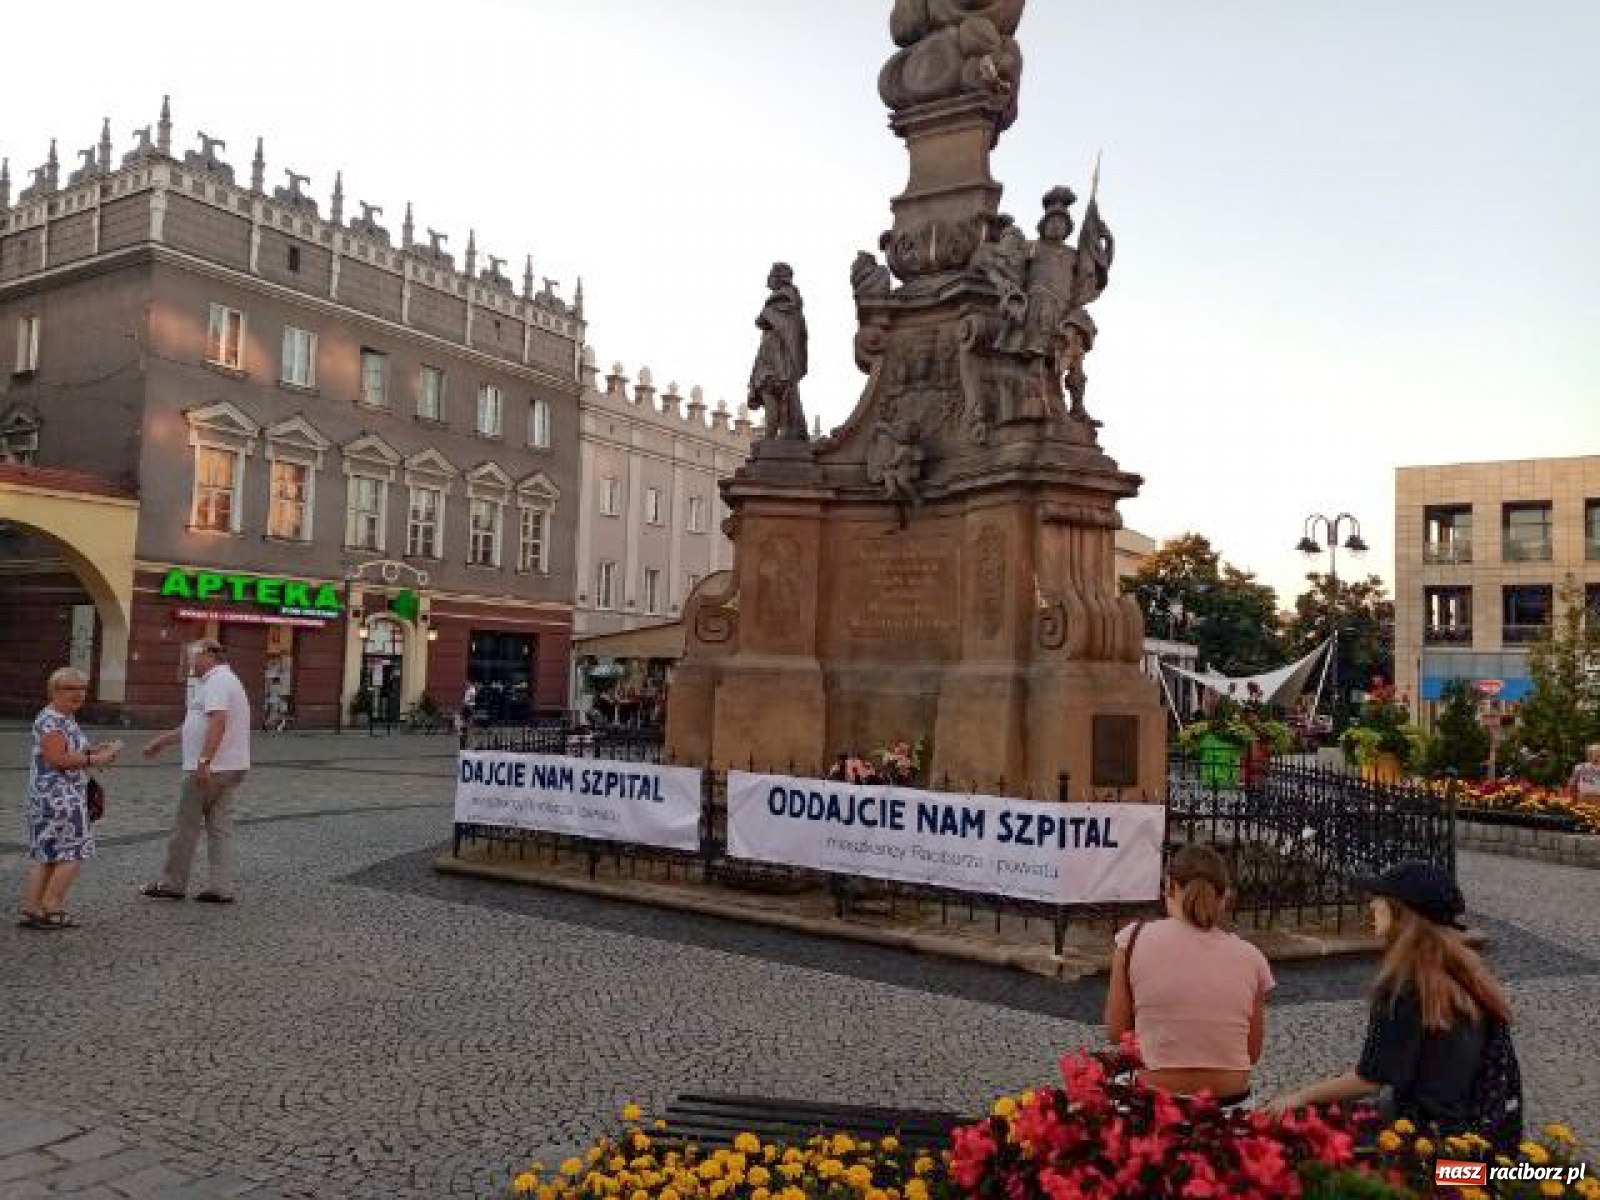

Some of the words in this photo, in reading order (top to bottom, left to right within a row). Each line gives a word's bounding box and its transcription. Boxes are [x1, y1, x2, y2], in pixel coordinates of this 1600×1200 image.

[161, 569, 340, 607] APTEKA
[461, 759, 526, 788] DAJCIE
[530, 764, 574, 793] NAM
[580, 769, 665, 803] SZPITAL
[768, 786, 906, 831] ODDAJCIE
[916, 802, 986, 840] NAM
[996, 811, 1119, 849] SZPITAL
